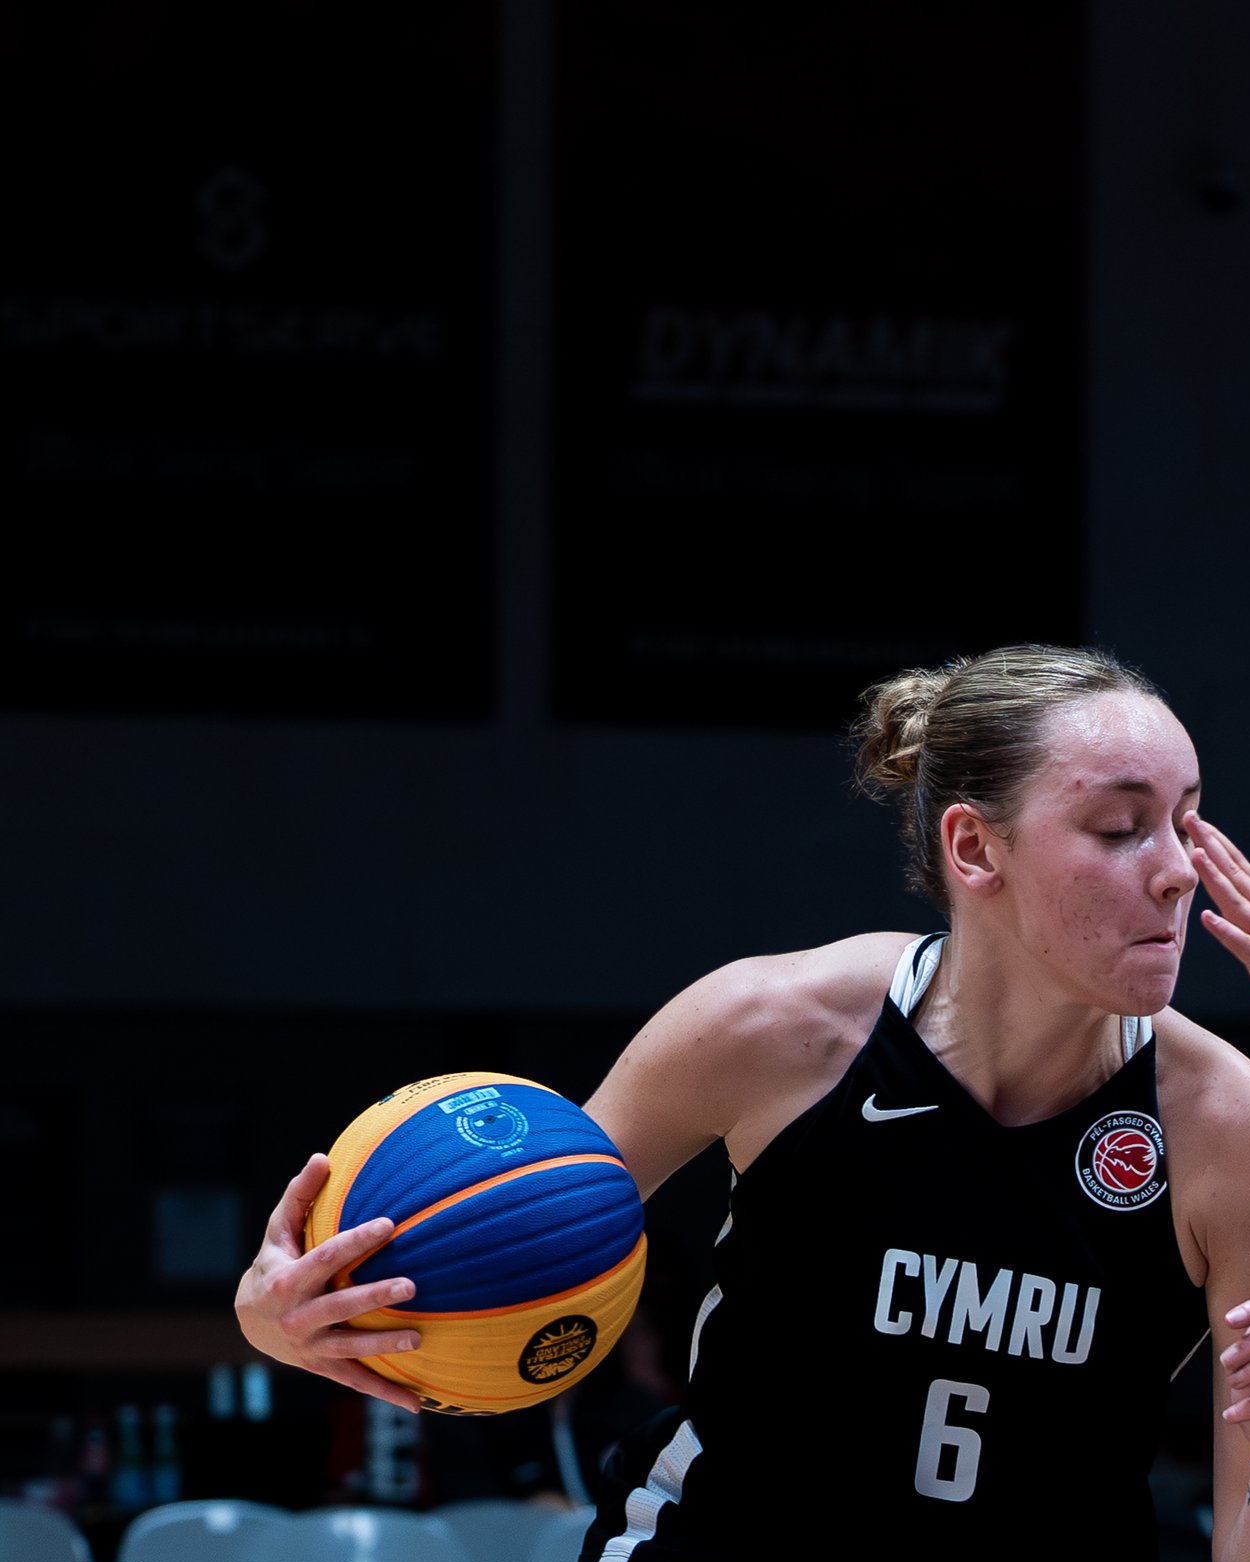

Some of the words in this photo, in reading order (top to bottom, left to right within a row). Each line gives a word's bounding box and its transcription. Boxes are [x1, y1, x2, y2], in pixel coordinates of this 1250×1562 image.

[1083, 1168, 1130, 1204] BASKETBALL
[1131, 1181, 1159, 1203] WALES
[874, 1248, 1101, 1364] CYMRU
[914, 1378, 991, 1502] 6
